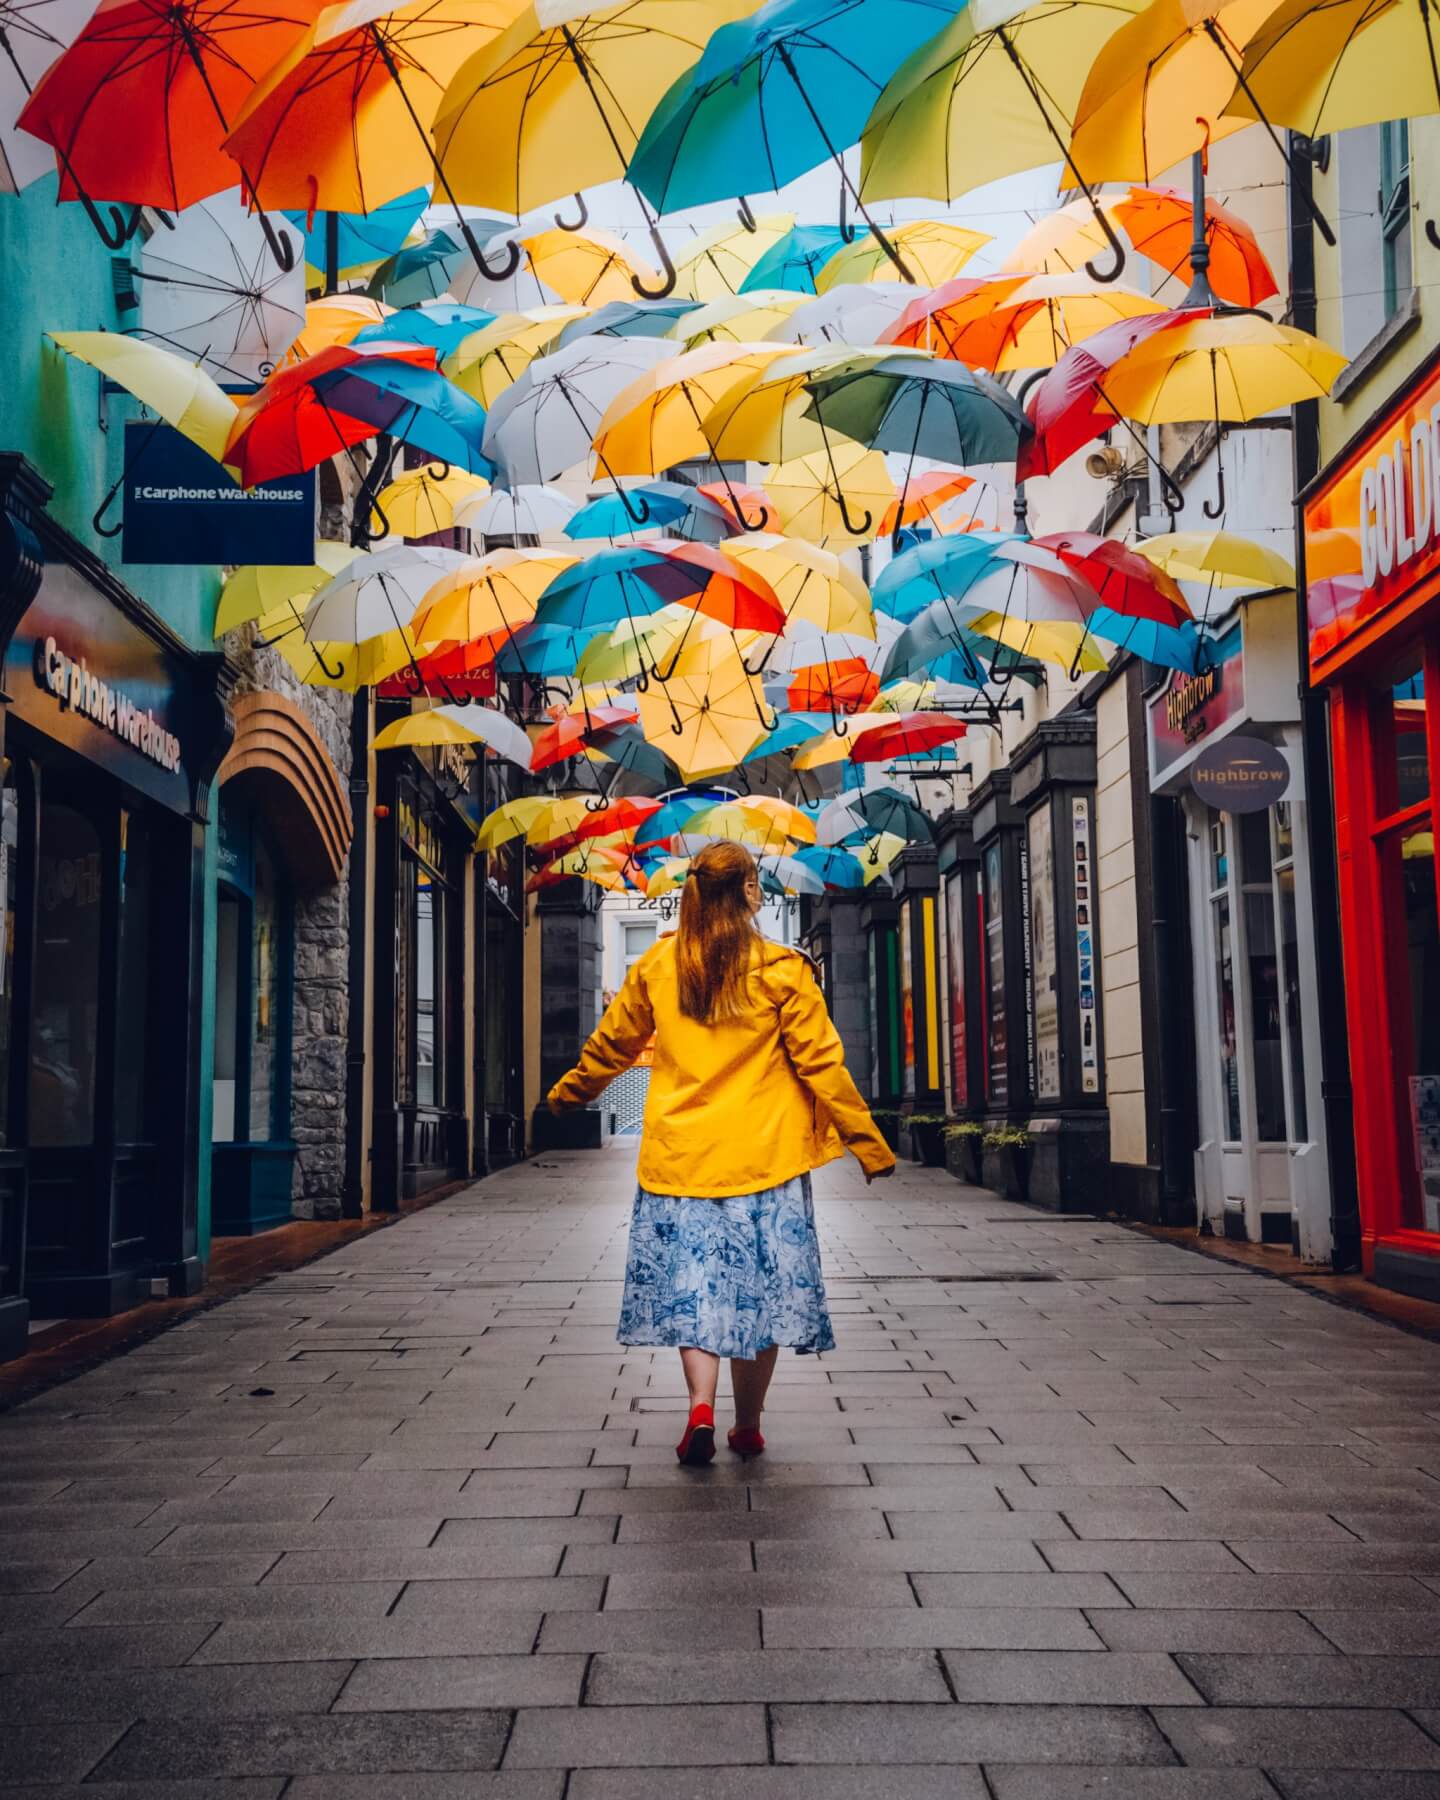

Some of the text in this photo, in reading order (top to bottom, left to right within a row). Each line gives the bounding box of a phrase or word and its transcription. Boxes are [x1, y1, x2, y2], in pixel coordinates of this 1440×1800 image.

[142, 486, 217, 501] Carphone
[44, 636, 116, 731] Carphone
[1196, 768, 1283, 784] Highbrow
